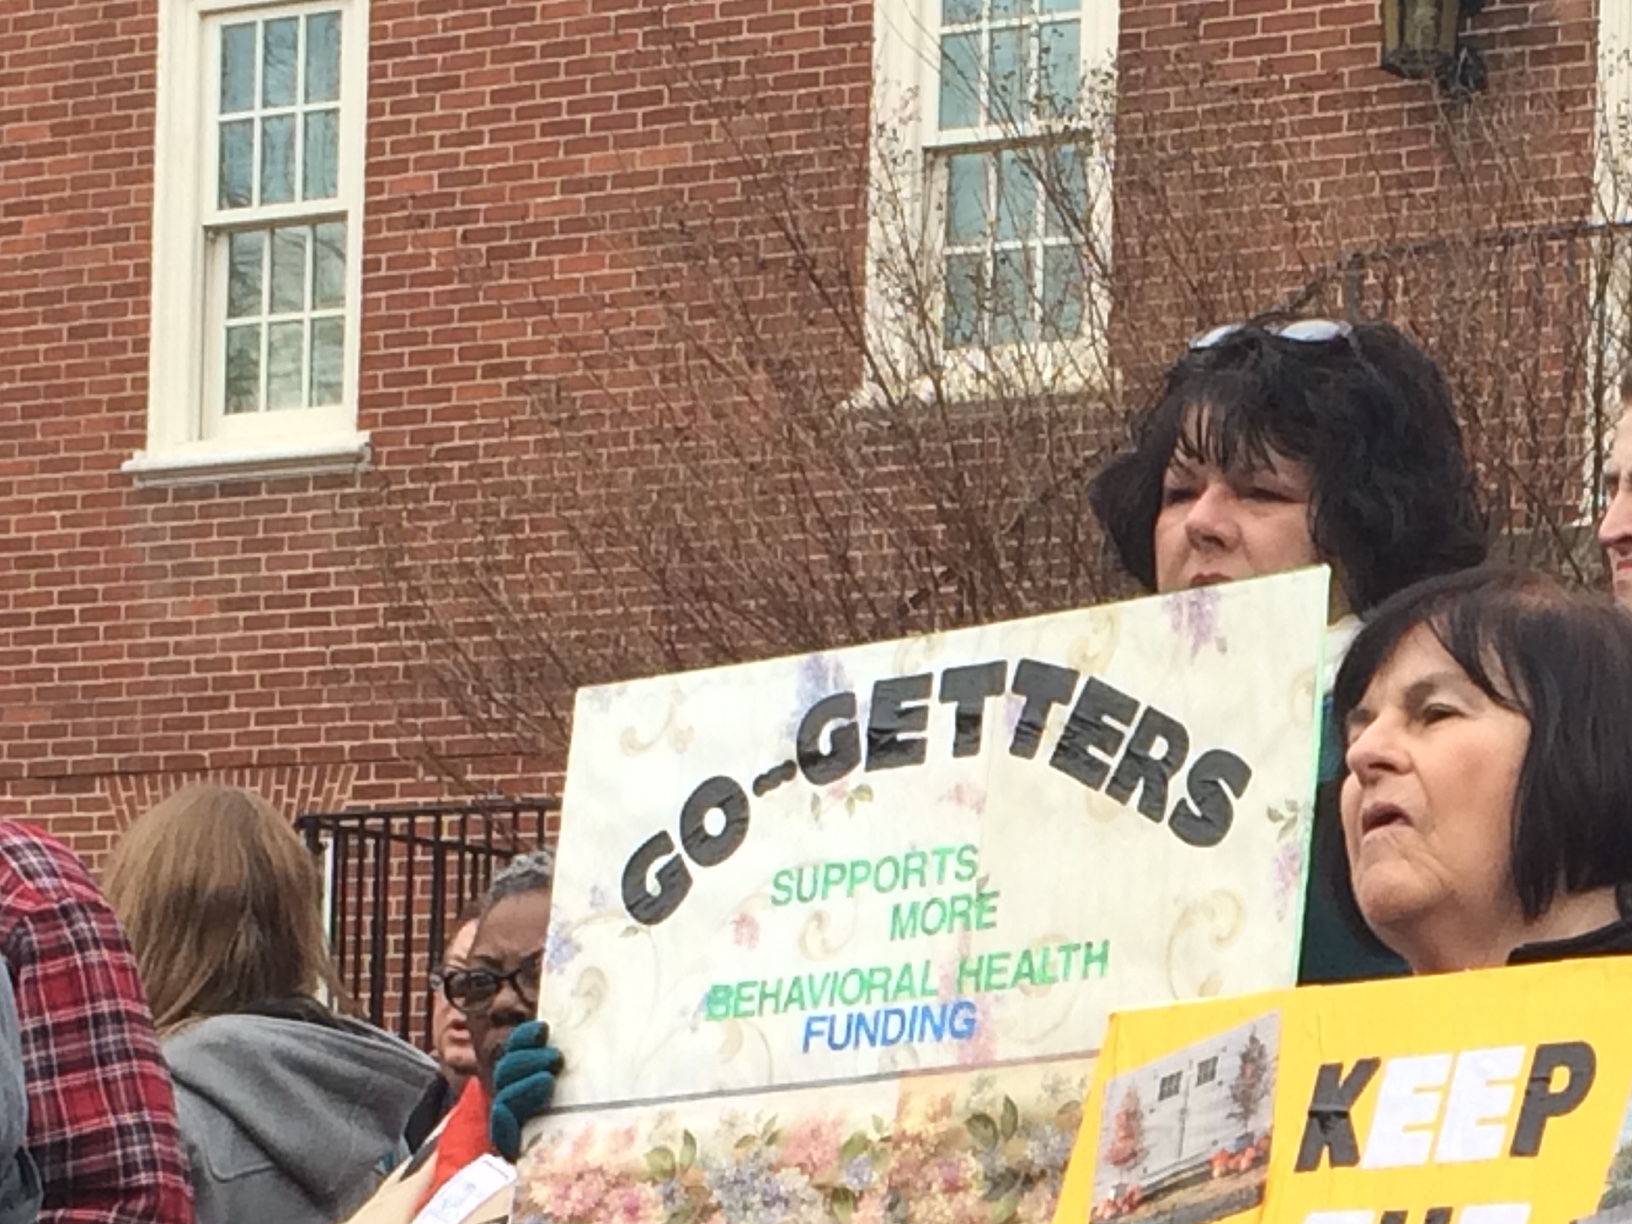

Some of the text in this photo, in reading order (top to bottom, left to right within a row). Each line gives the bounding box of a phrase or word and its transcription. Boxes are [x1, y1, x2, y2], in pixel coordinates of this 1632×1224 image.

[620, 658, 1252, 926] GO-GETTERS
[770, 845, 979, 905] SUPPORTS
[889, 892, 999, 942] MORE
[704, 940, 1110, 1022] BEHAVIORAL HEALTH
[803, 1002, 976, 1052] FUNDING
[1295, 1041, 1596, 1172] KEEP
